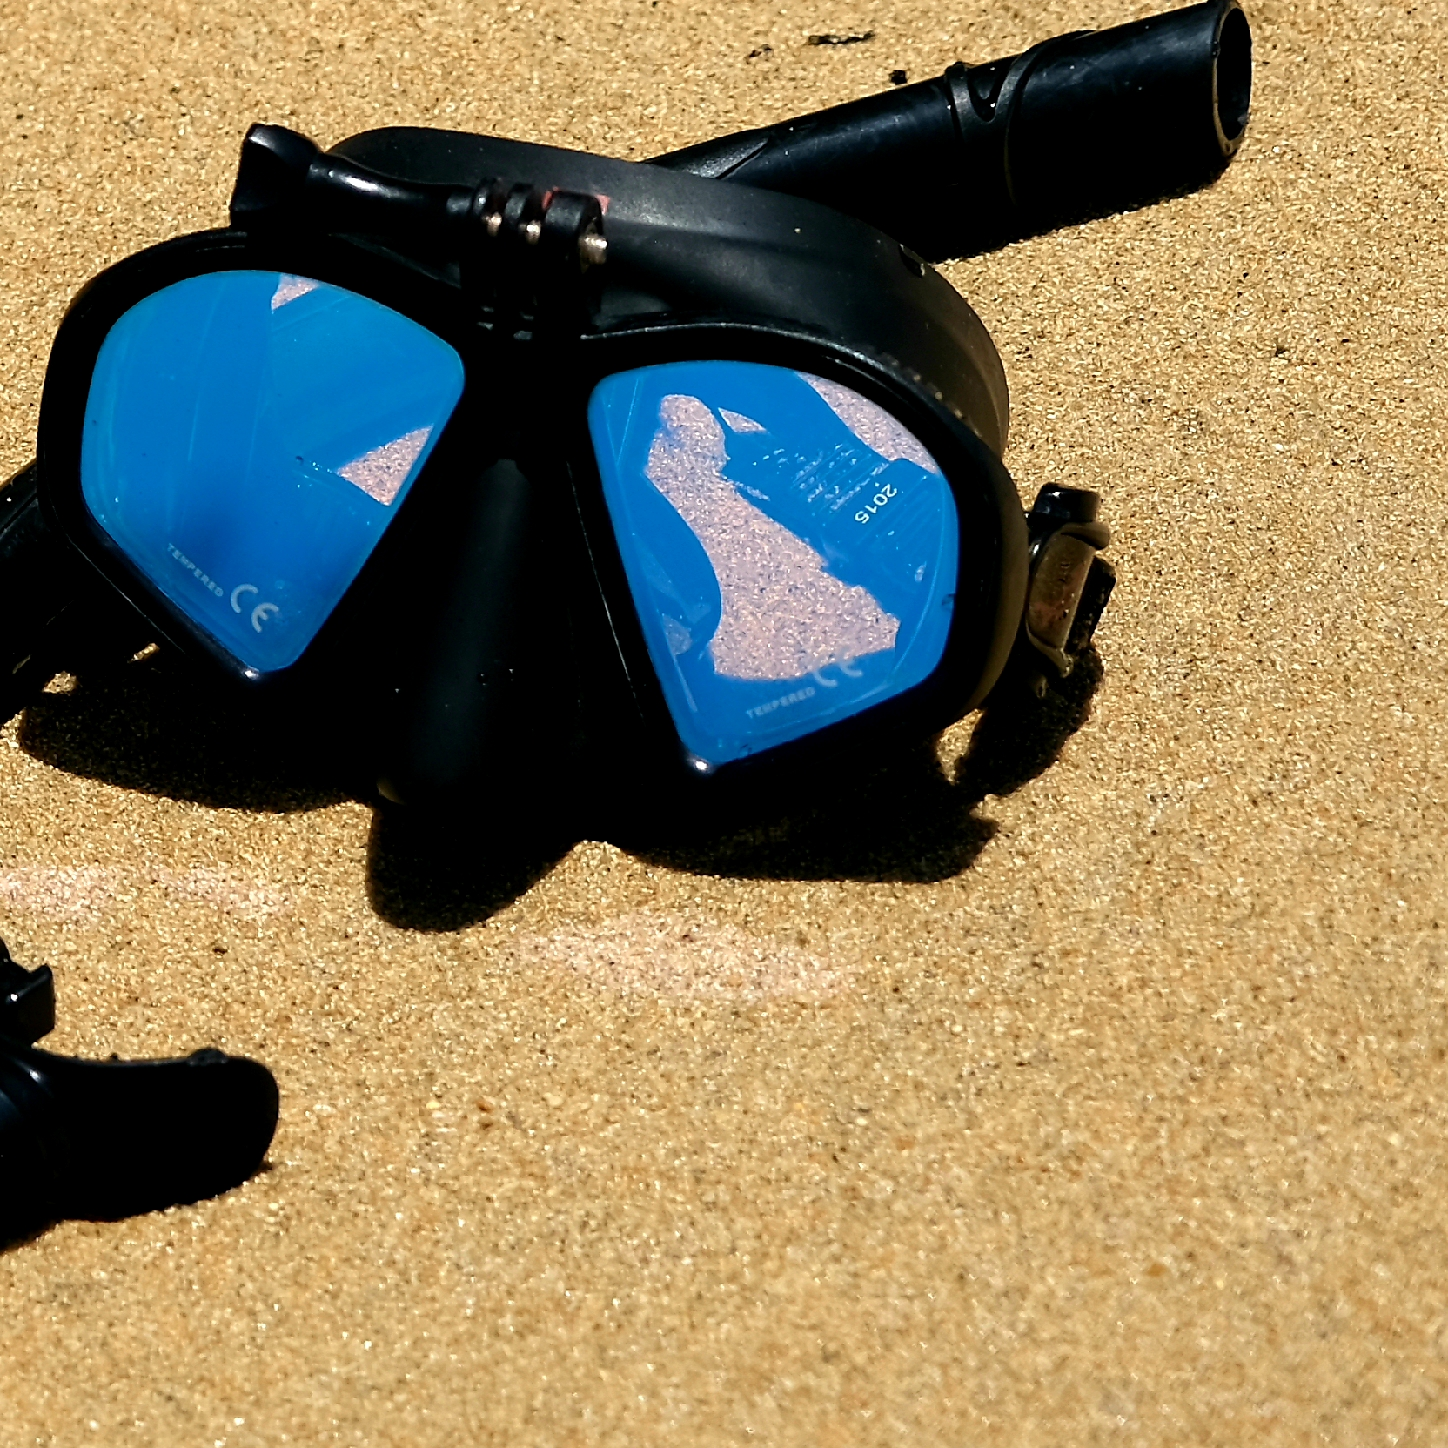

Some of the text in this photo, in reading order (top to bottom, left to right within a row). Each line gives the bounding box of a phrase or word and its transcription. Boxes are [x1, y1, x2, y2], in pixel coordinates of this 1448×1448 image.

[853, 483, 898, 525] 2015
[167, 542, 280, 634] TEMPERED CE
